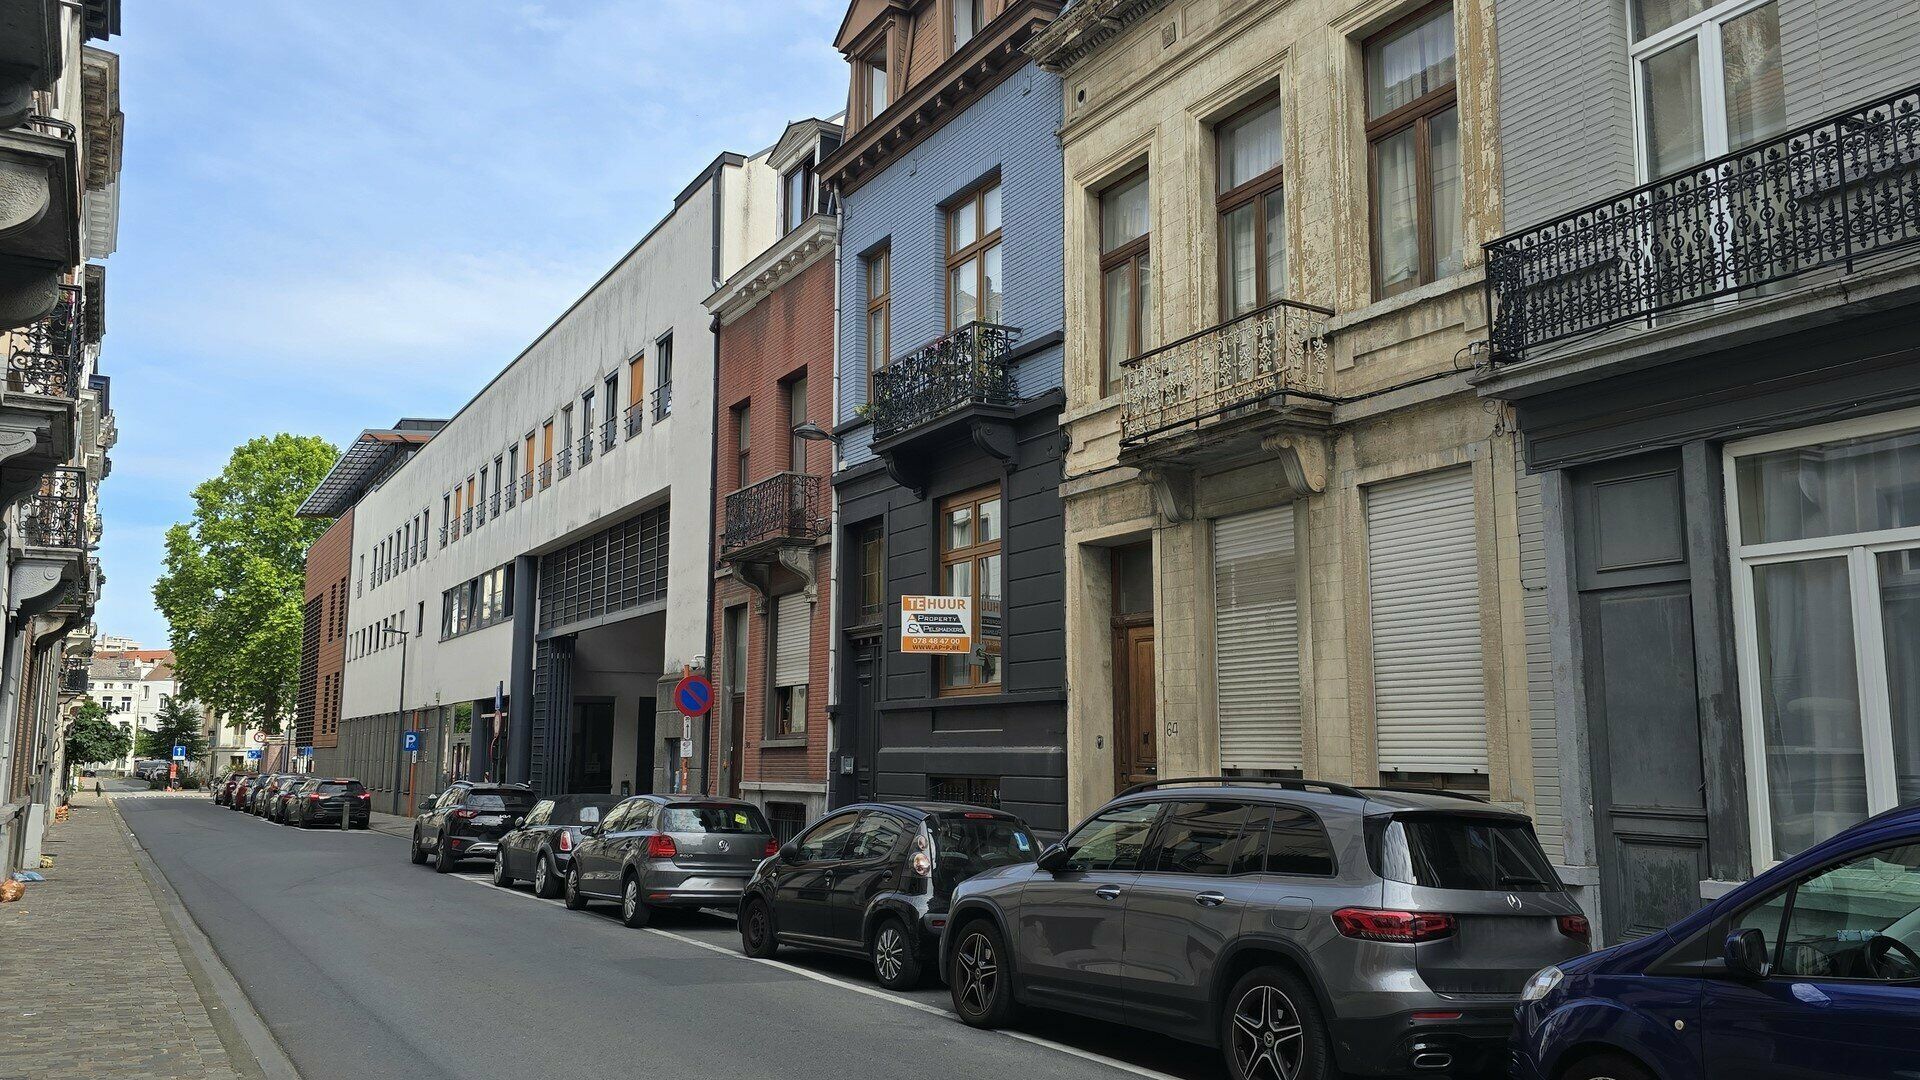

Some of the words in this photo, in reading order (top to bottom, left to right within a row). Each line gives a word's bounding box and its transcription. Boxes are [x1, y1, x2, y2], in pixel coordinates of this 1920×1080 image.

[908, 598, 925, 609] TE
[928, 599, 966, 610] HUUR
[1166, 722, 1179, 737] 64
[405, 734, 417, 748] P
